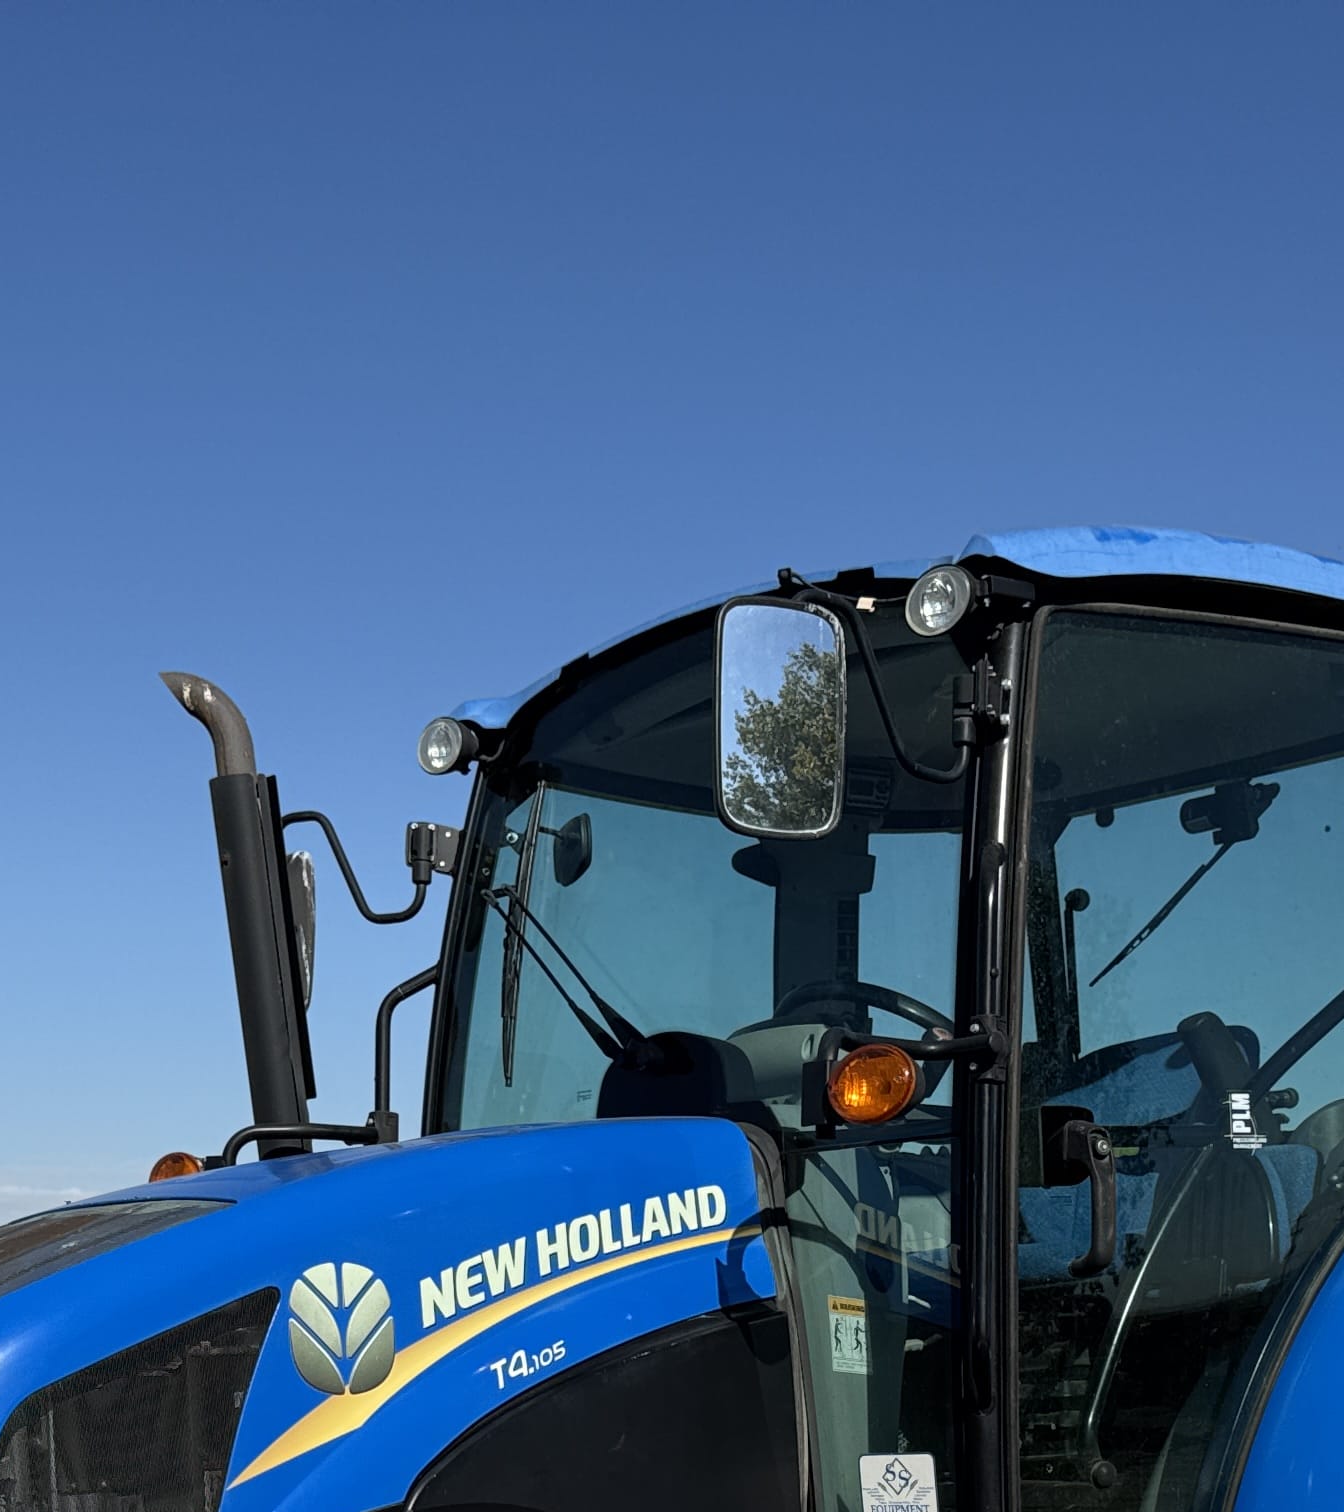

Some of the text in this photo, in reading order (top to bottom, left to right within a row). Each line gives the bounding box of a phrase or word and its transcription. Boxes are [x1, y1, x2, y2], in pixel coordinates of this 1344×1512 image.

[1231, 1093, 1251, 1133] PLM
[419, 1183, 727, 1330] NEW HOLLAND
[490, 1339, 566, 1390] T4.105
